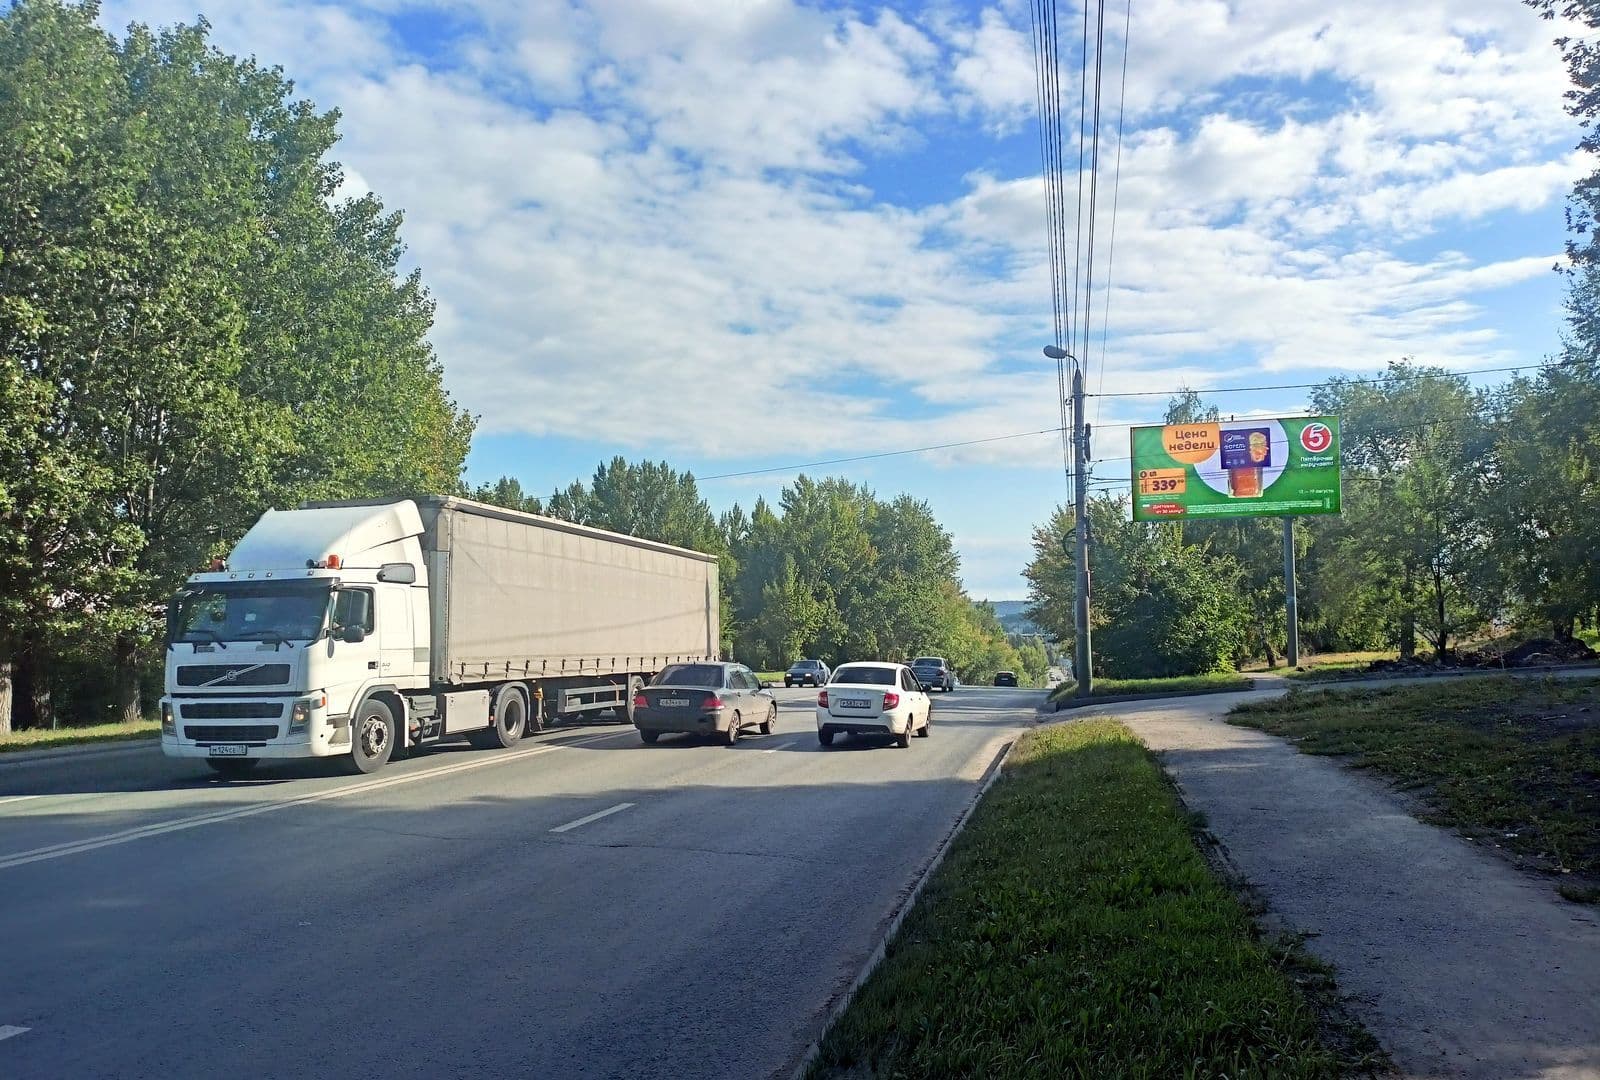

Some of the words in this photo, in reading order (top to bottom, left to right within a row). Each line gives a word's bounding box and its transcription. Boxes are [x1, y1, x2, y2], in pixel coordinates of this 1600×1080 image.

[1175, 430, 1208, 440] Цена
[1308, 424, 1326, 447] 5
[1169, 441, 1215, 451] недели
[1152, 479, 1177, 491] 339
